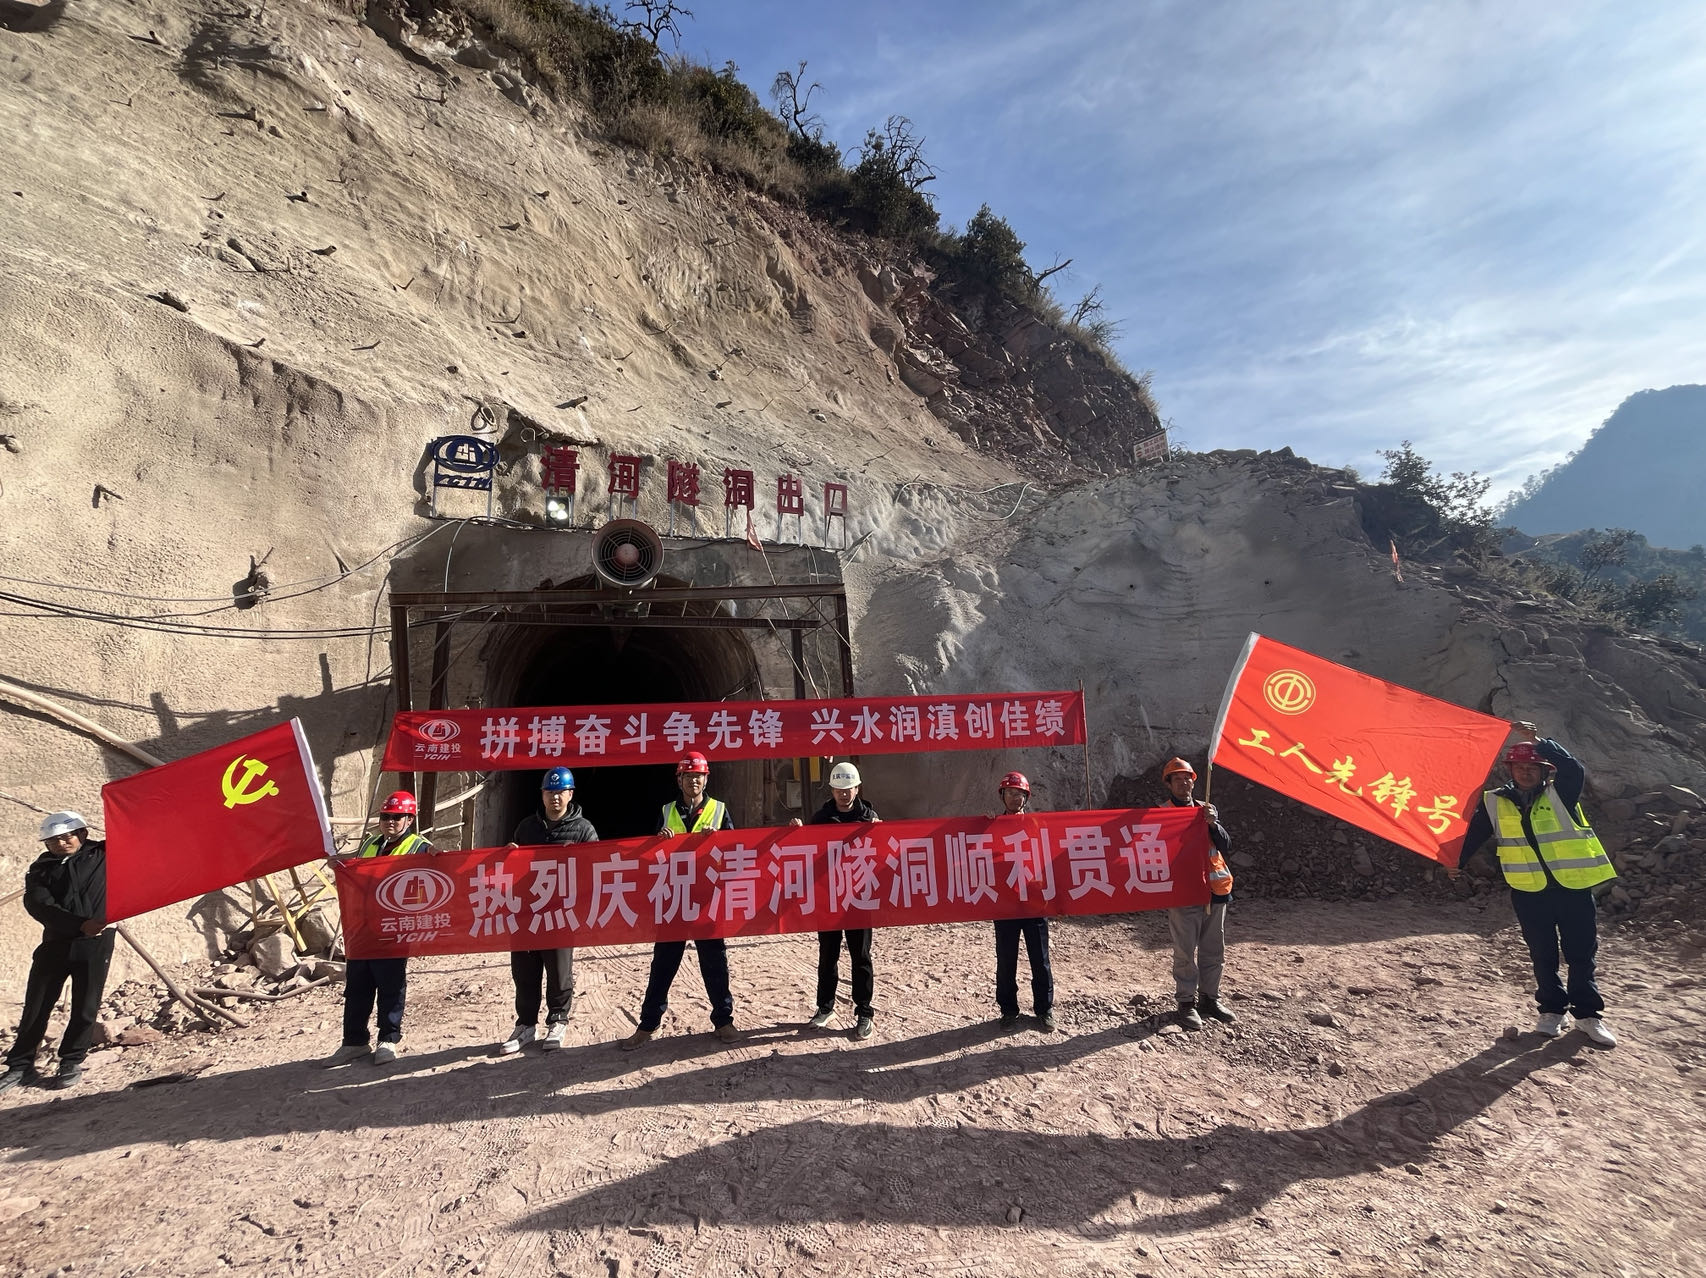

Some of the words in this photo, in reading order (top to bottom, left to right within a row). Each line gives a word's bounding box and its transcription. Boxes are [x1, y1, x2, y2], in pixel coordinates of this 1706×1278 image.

[541, 444, 848, 517] 清河隧洞出口
[415, 743, 461, 753] 云南建投
[480, 708, 784, 759] 拼搏奋斗争先锋
[810, 700, 1066, 745] 兴水润滇创佳绩
[1238, 727, 1461, 834] 工人先锋号
[468, 823, 1175, 938] 热烈庆祝清河隧洞顺利贯通
[381, 913, 451, 932] 云南建投
[396, 931, 438, 943] YCIH
